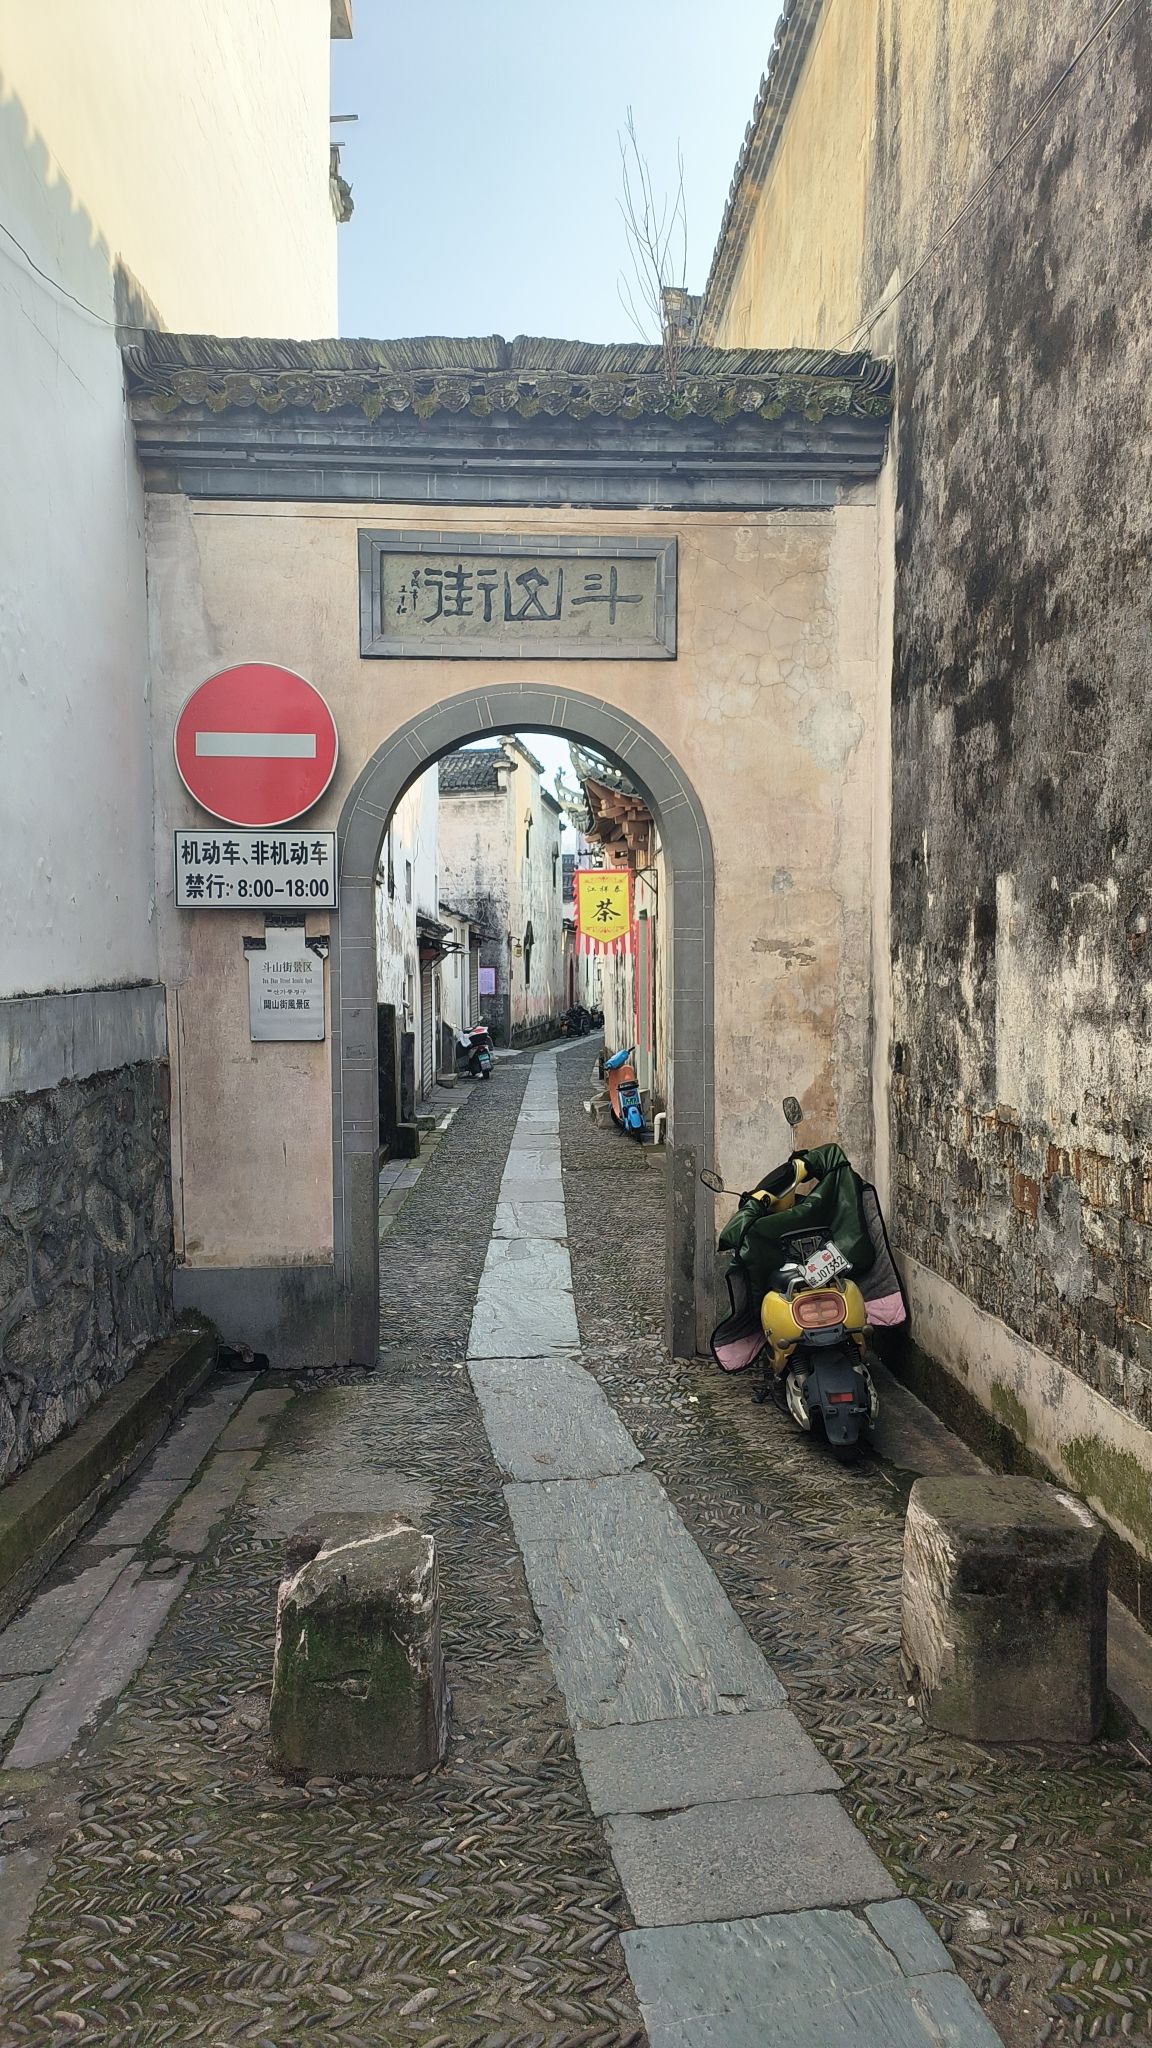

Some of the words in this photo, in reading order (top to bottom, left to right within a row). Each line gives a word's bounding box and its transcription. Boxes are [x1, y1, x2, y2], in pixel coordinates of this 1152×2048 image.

[181, 840, 328, 866] 机动车、非机动车
[591, 898, 621, 922] 茶
[262, 961, 312, 973] 斗山街景区
